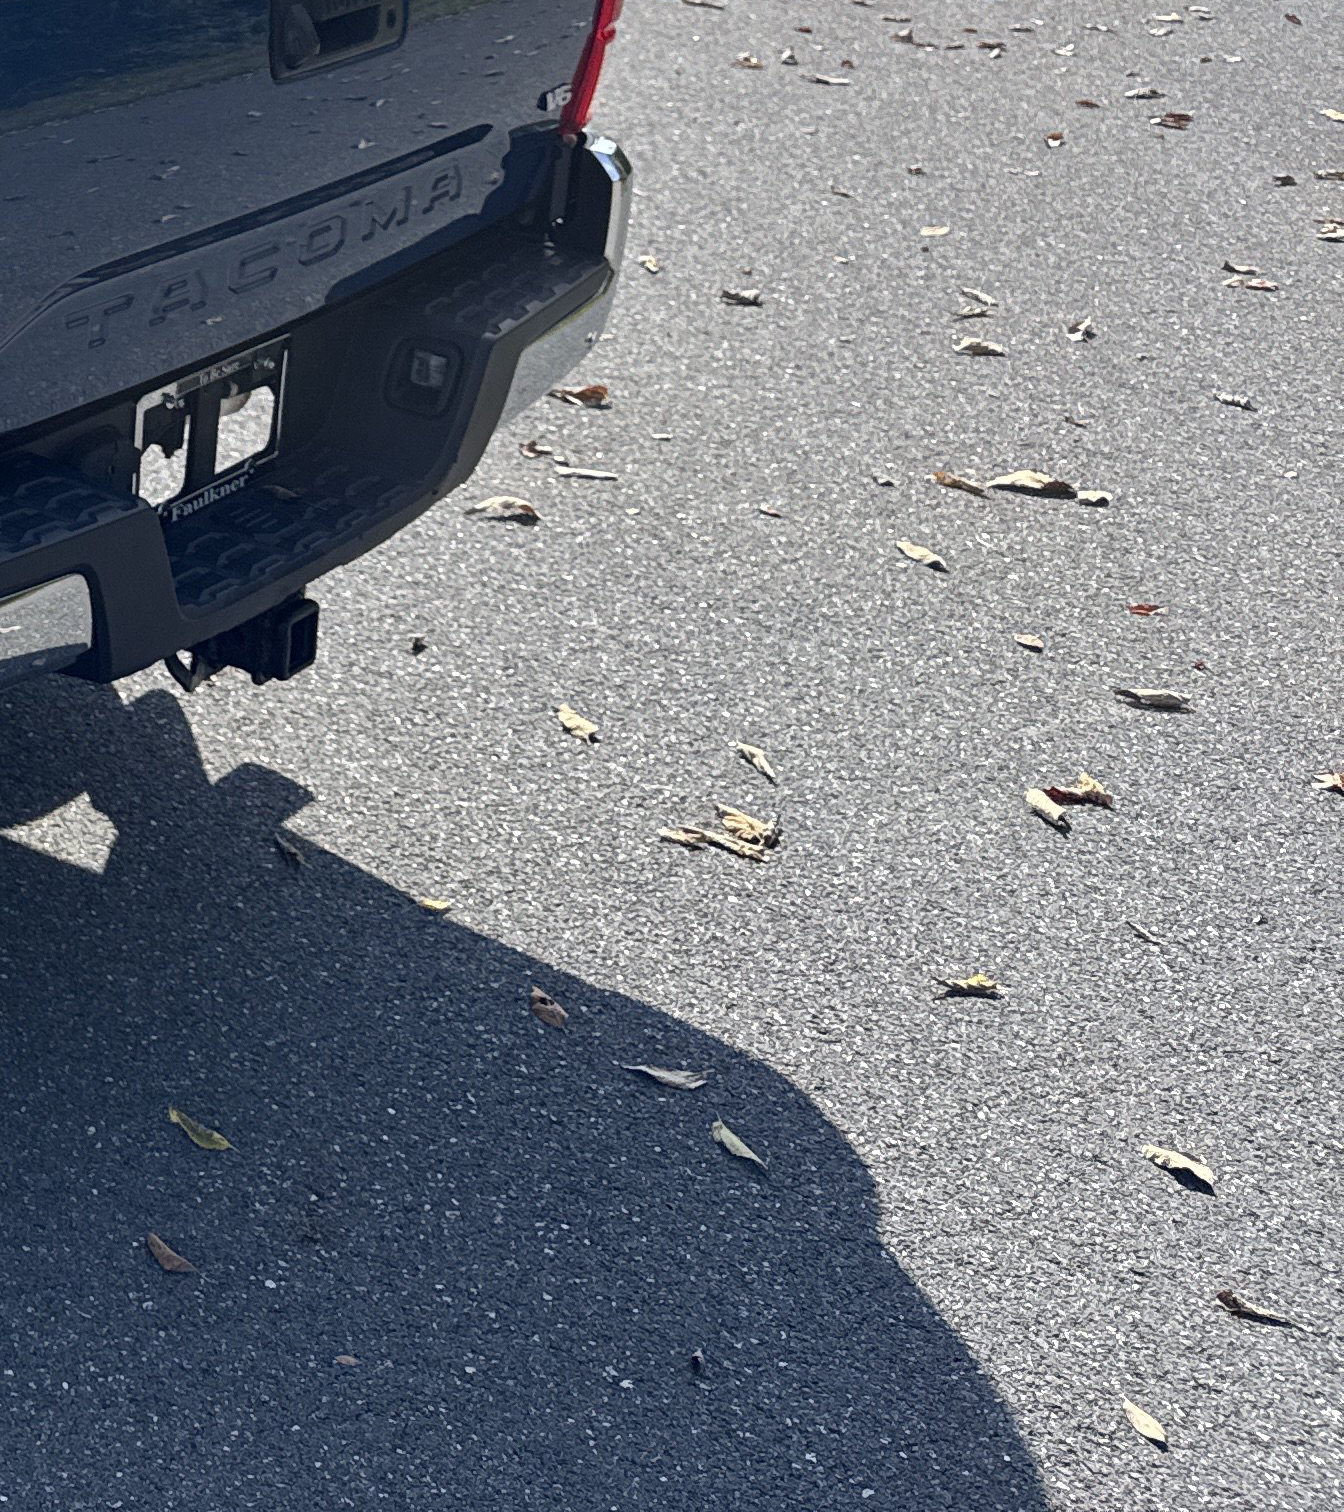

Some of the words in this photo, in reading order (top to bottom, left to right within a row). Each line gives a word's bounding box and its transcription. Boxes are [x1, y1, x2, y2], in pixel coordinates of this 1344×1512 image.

[545, 84, 573, 112] V6
[64, 159, 463, 350] TACOMA
[171, 474, 249, 522] Faulkner
